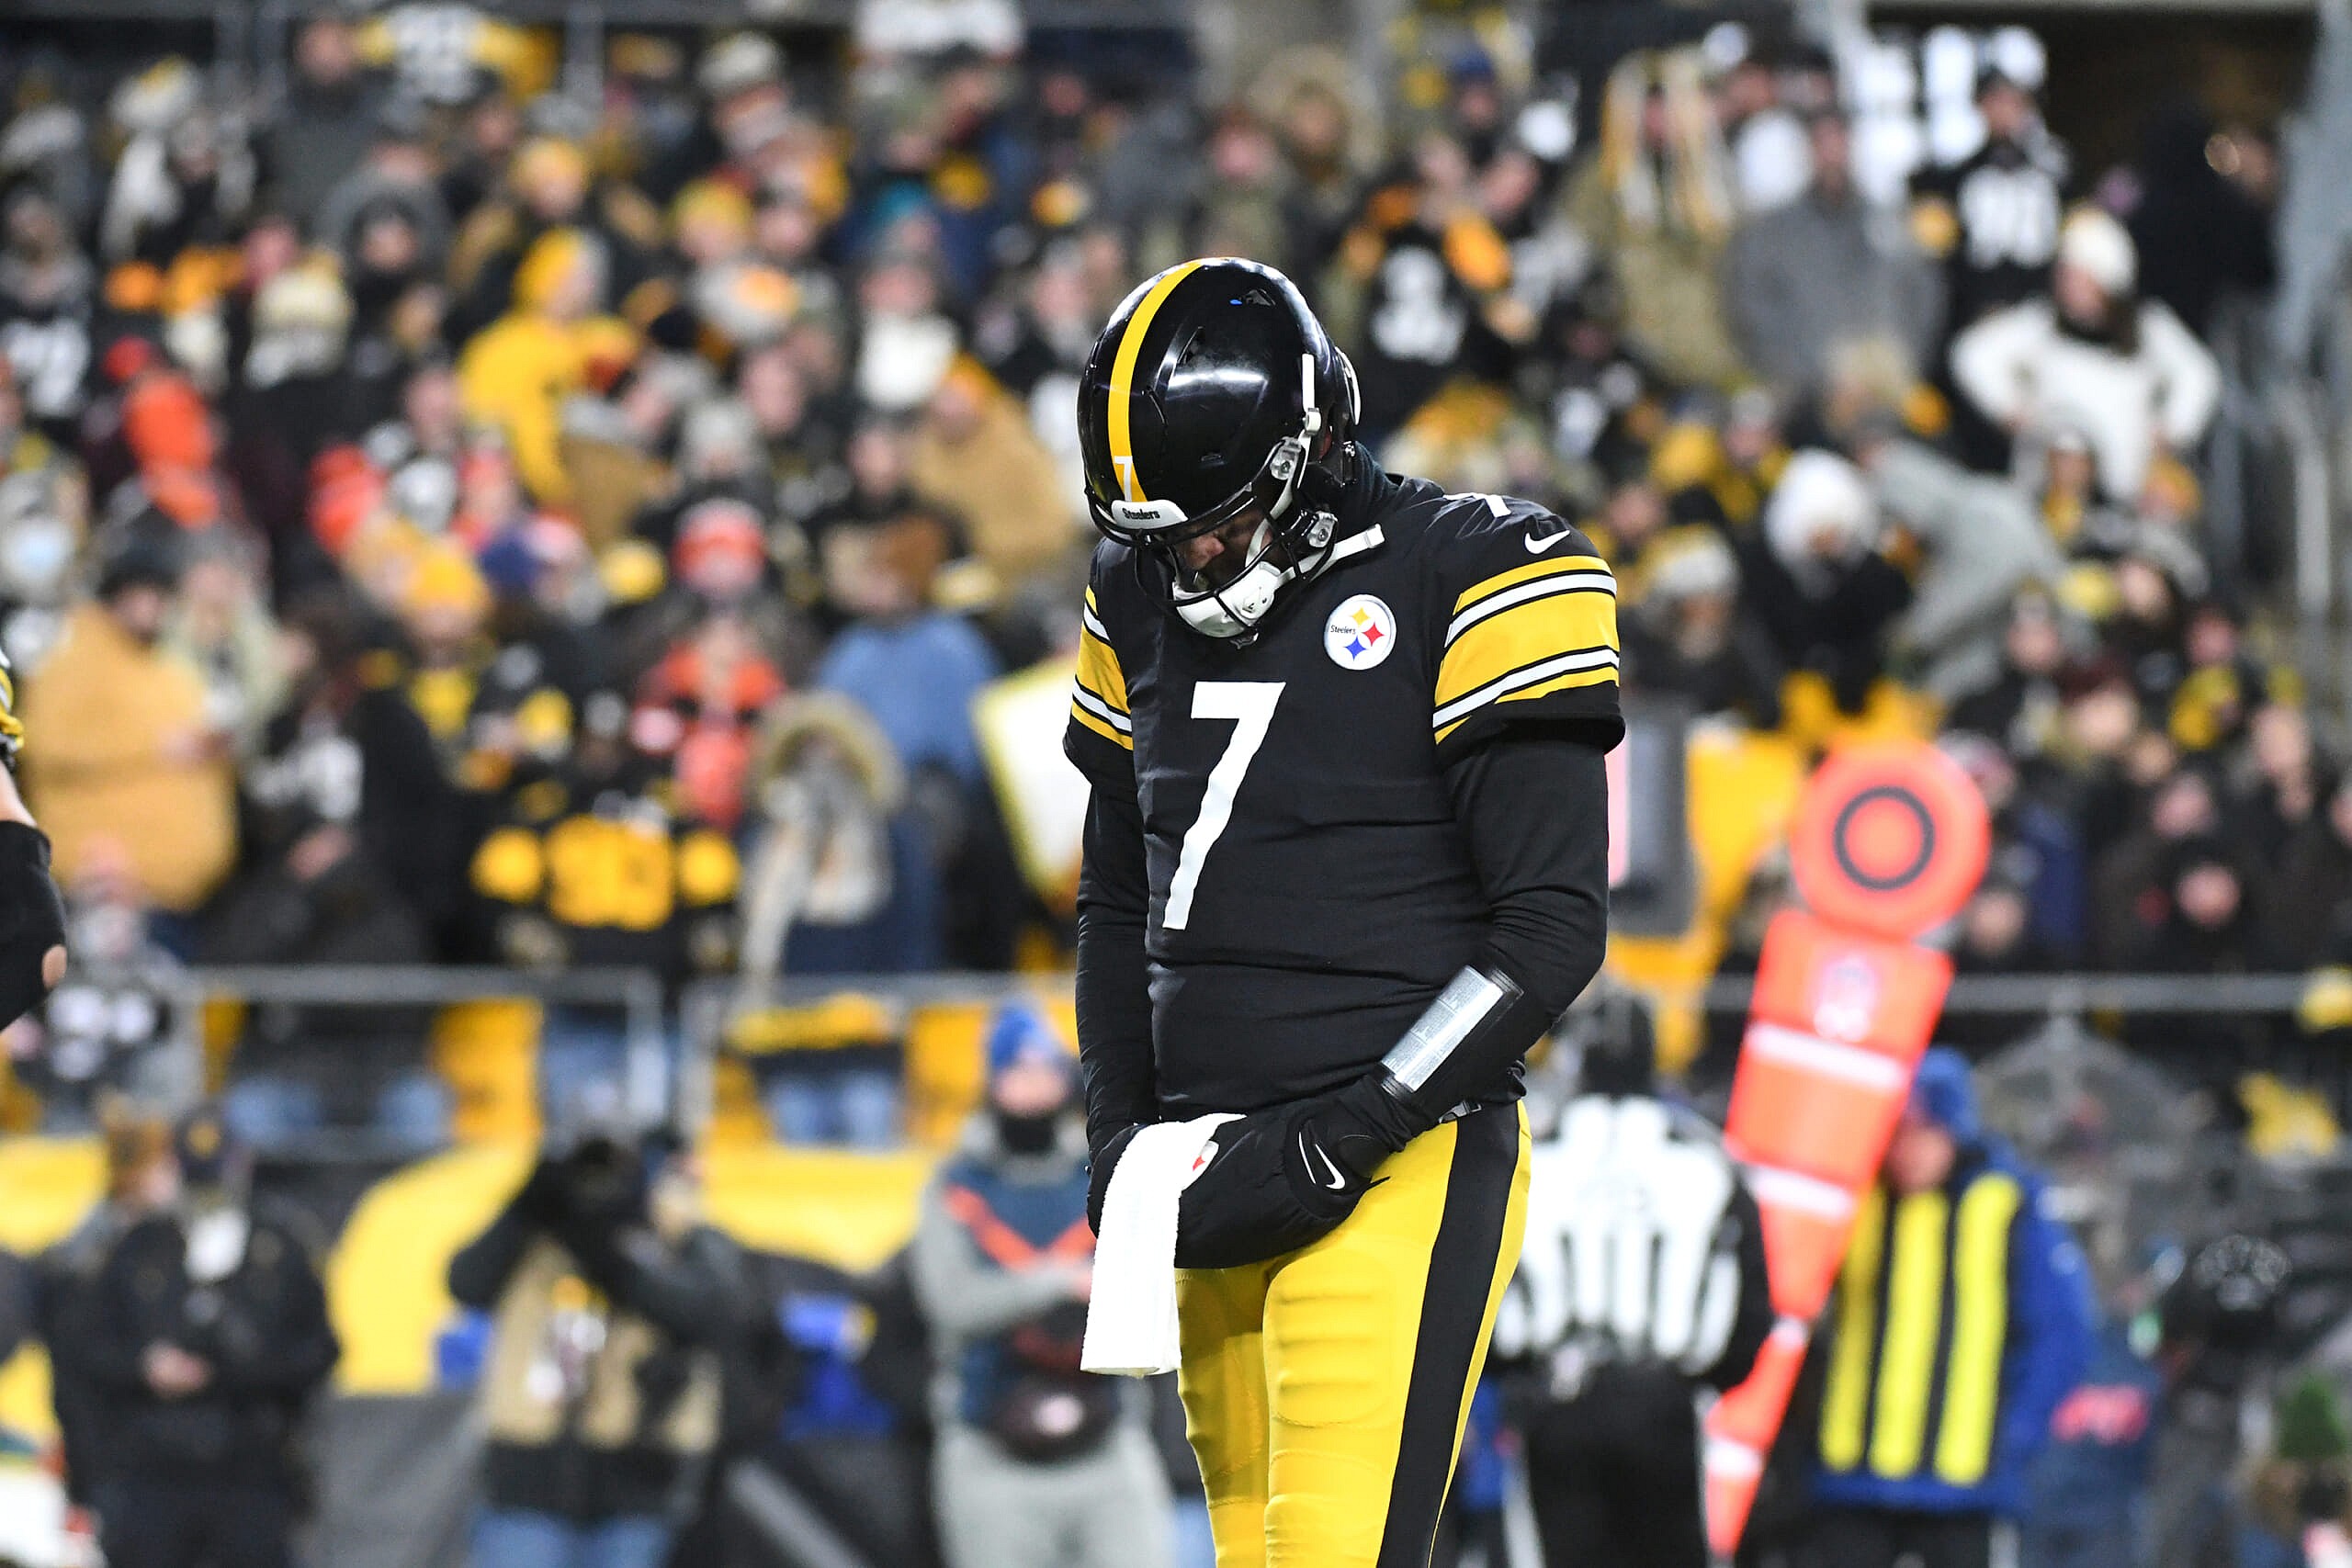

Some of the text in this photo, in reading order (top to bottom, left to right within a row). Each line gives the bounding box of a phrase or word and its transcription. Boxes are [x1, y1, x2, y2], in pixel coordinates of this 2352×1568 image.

[1114, 456, 1133, 502] 7
[1122, 507, 1160, 520] Steelers
[1329, 625, 1356, 635] Steelers
[1163, 682, 1284, 930] 7
